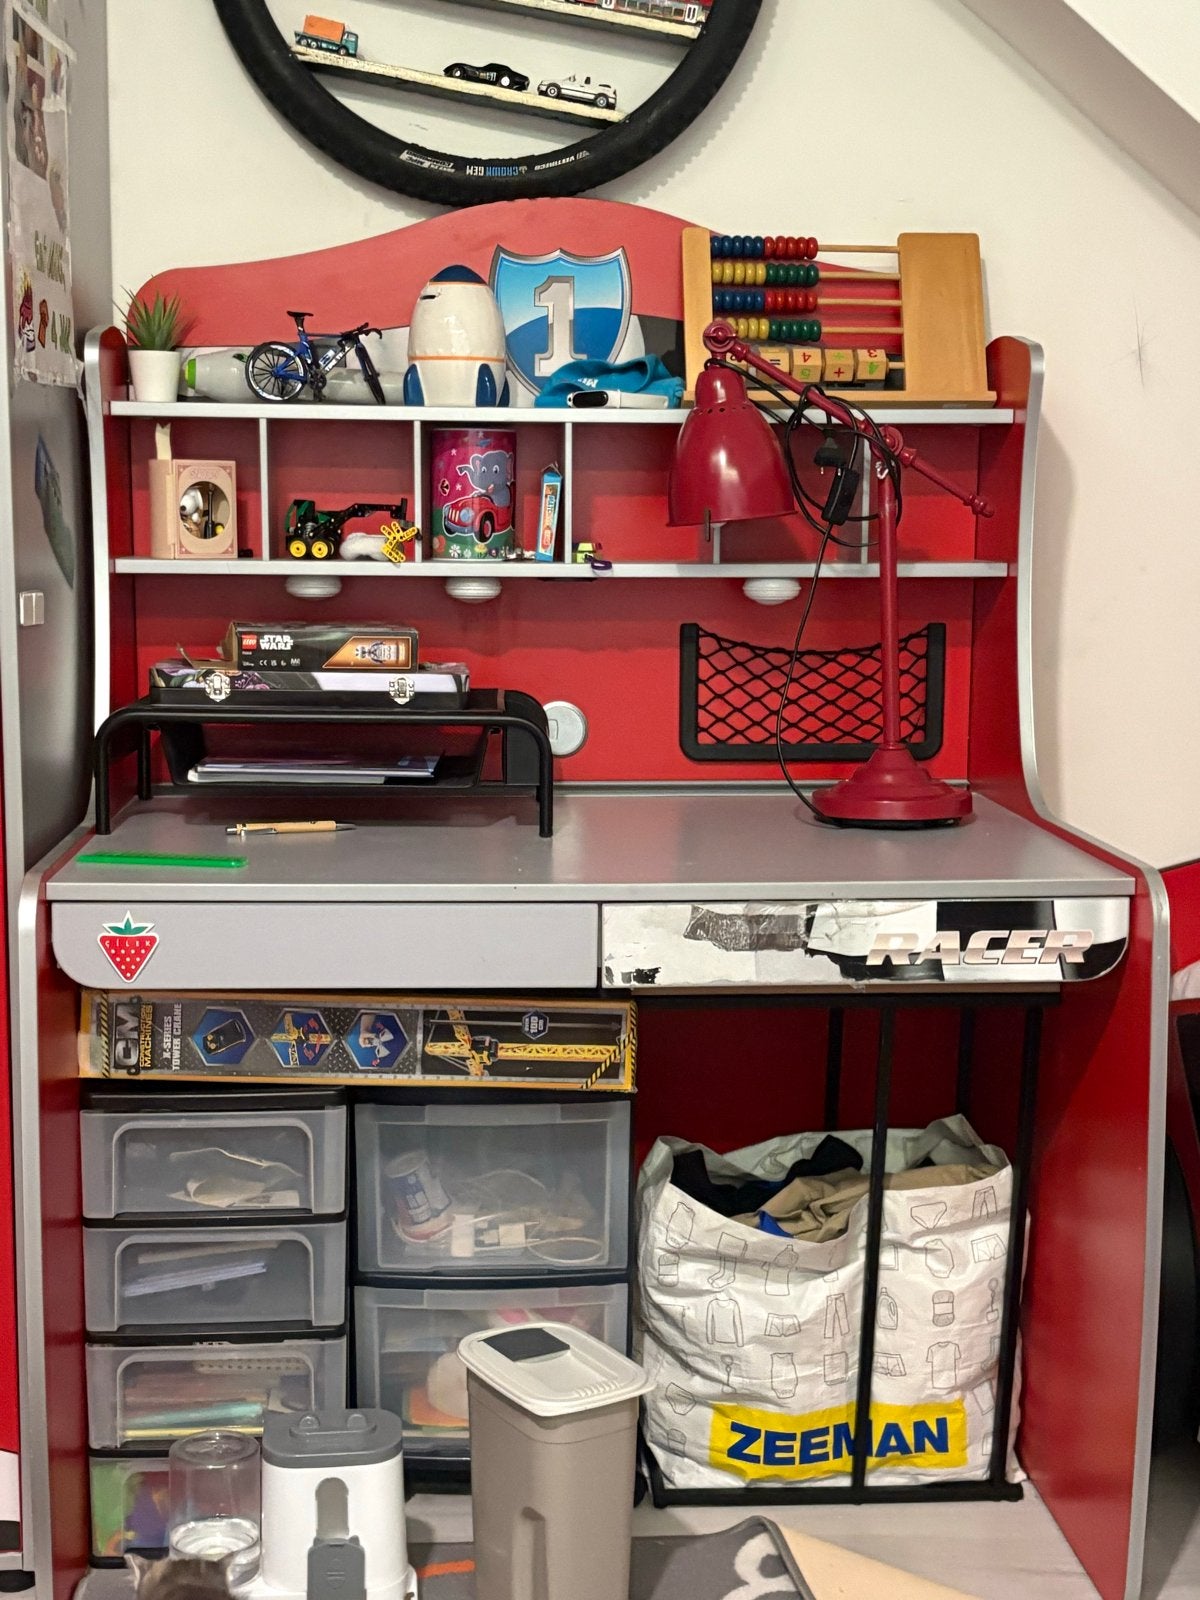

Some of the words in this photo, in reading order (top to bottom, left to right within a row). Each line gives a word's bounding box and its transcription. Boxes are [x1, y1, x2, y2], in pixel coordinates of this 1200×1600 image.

[466, 165, 484, 176] GEM
[486, 166, 518, 177] CROWN
[534, 275, 588, 377] 1
[800, 352, 811, 363] 4
[260, 641, 294, 650] WARS
[261, 634, 293, 642] STAR
[866, 929, 1095, 967] RACER
[115, 1004, 139, 1067] CM
[145, 1004, 153, 1067] MACHINES
[173, 1002, 182, 1036] CRANE
[530, 1015, 538, 1033] 100
[162, 1015, 172, 1059] X-SERIES
[172, 1038, 181, 1071] TOWER
[727, 1416, 950, 1466] ZEEMAN
